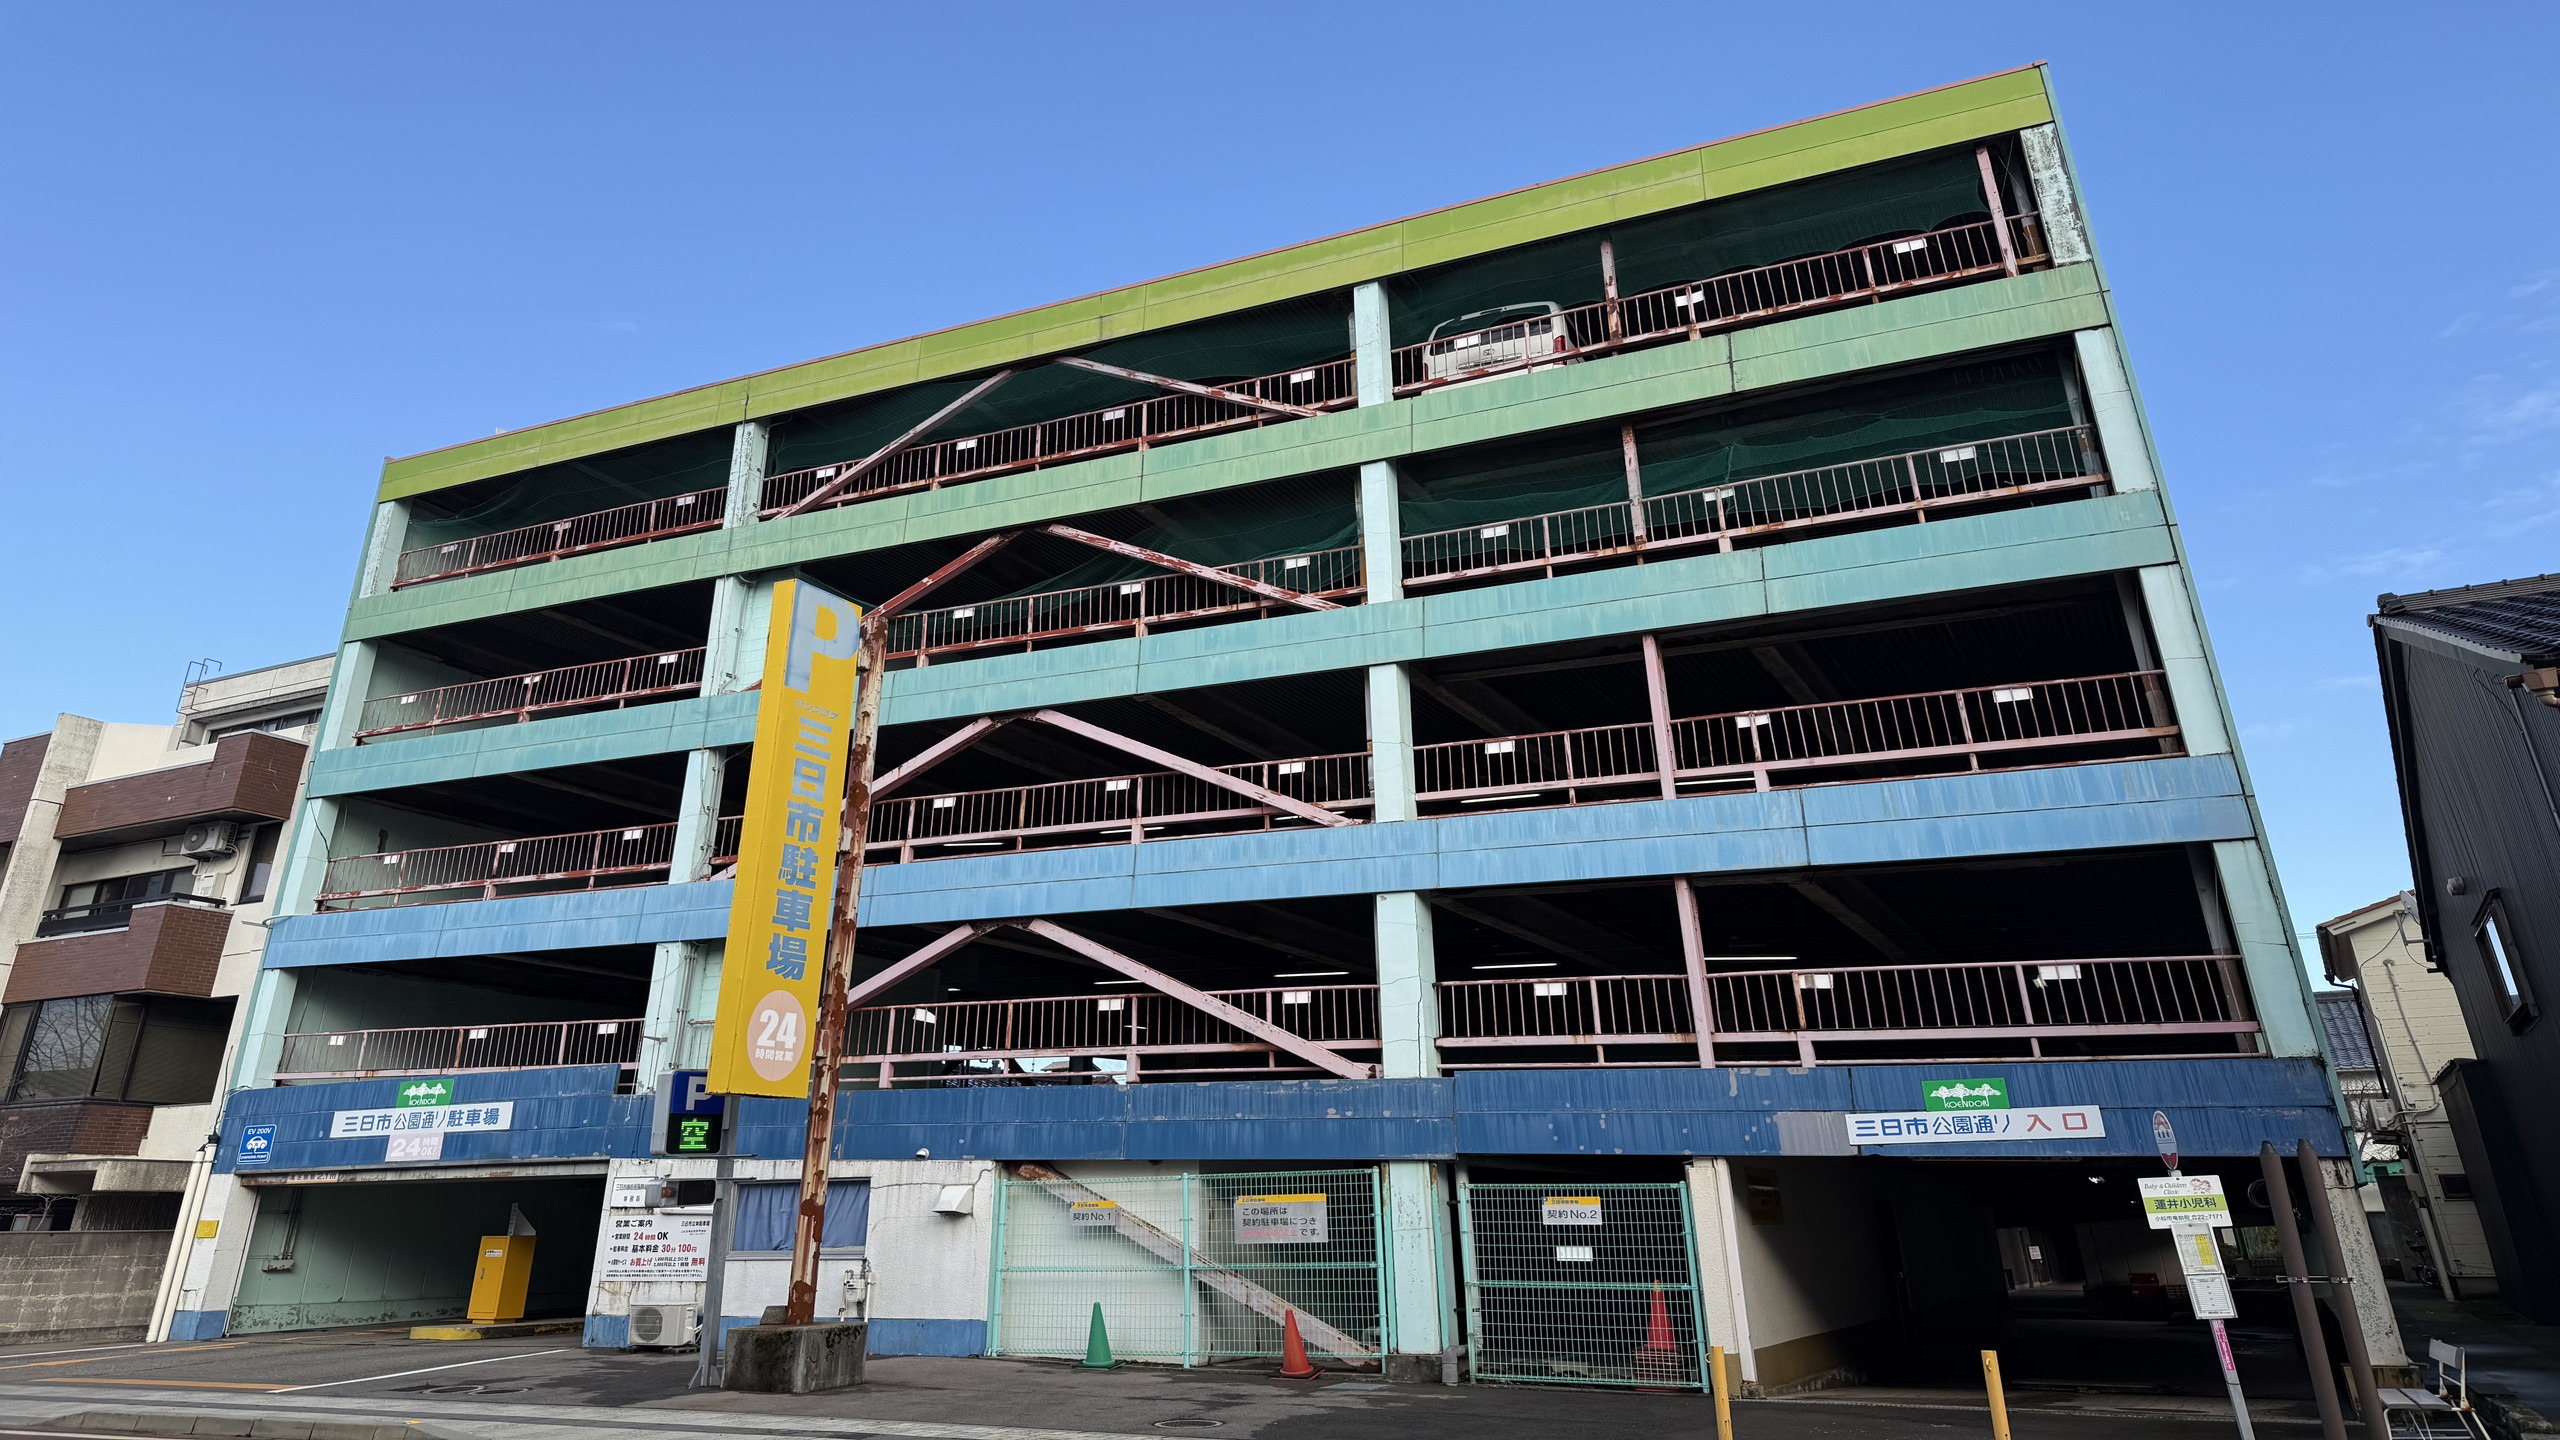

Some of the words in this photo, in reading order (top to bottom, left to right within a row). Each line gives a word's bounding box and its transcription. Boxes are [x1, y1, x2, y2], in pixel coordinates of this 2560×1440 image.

[784, 579, 860, 693] P
[766, 716, 833, 981] 三日市駐車場
[756, 1008, 798, 1049] 24
[755, 1048, 793, 1062] 時間営業
[685, 1076, 713, 1111] P
[341, 1107, 500, 1132] 三日市公園通り駐車場
[1855, 1114, 2010, 1137] 三日市公園通り
[2026, 1112, 2088, 1132] 入口
[678, 1117, 709, 1150] 空
[390, 1137, 421, 1157] 24
[421, 1146, 437, 1156] OK!
[2144, 1183, 2158, 1191] Baby
[1242, 1207, 1288, 1216] この場所は
[615, 1219, 653, 1228] 営業ご案内
[1242, 1217, 1317, 1227] 契約駐車場につき
[631, 1245, 659, 1253] 基本料金
[690, 1257, 706, 1267] 無料
